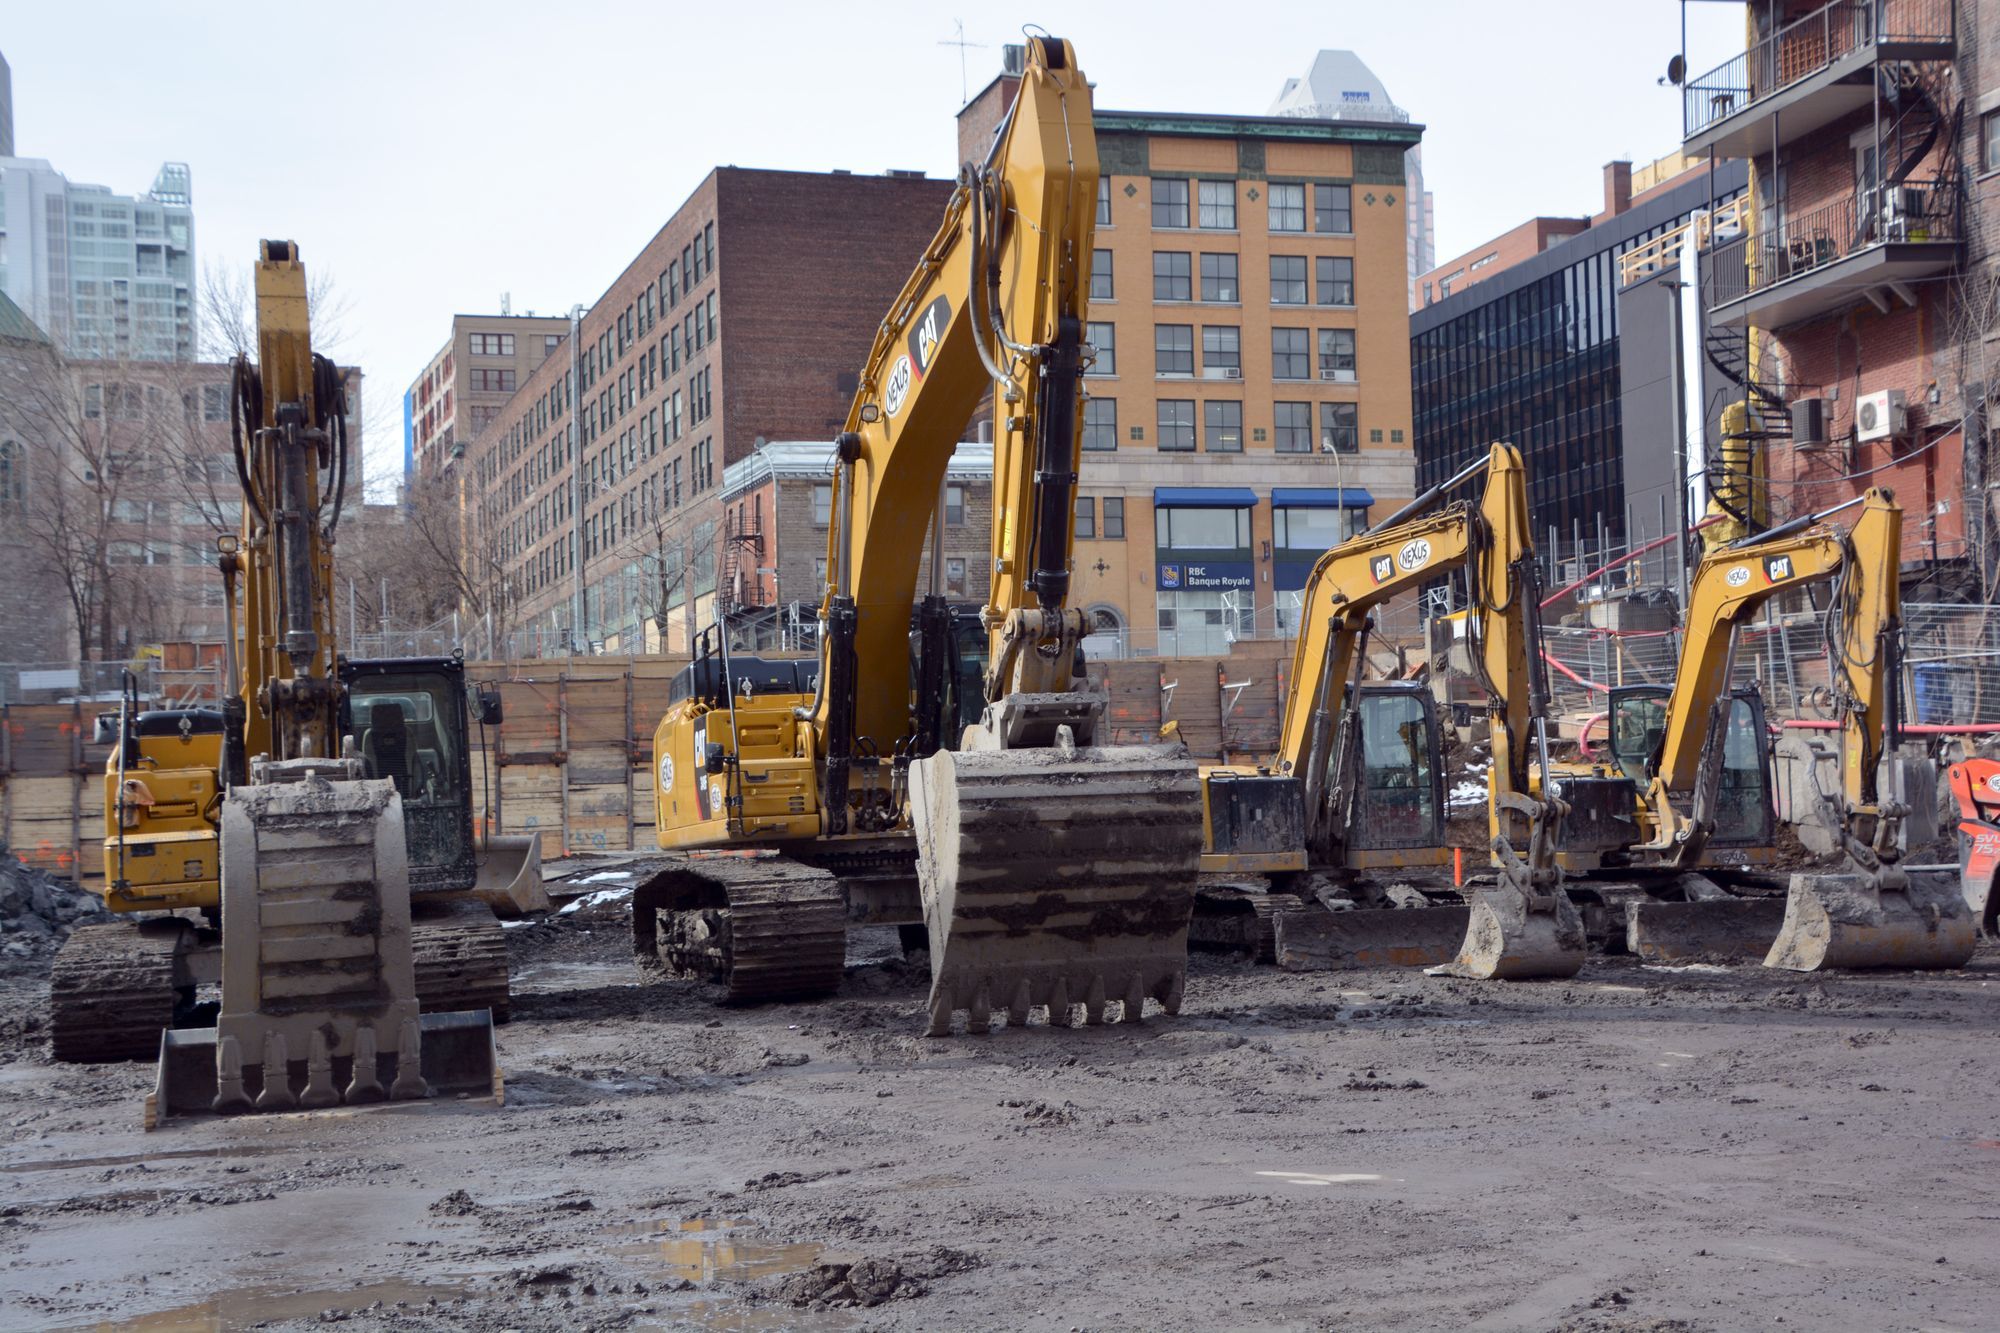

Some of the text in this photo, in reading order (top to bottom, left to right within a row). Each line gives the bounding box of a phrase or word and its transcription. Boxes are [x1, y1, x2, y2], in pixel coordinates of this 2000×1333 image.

[919, 304, 938, 368] CAT
[887, 357, 909, 412] NEXUS
[1402, 540, 1427, 568] NEXUS
[1188, 567, 1206, 576] RBC
[1376, 557, 1391, 581] CAT
[1770, 557, 1788, 580] CAT
[1188, 576, 1251, 587] Banque Royale
